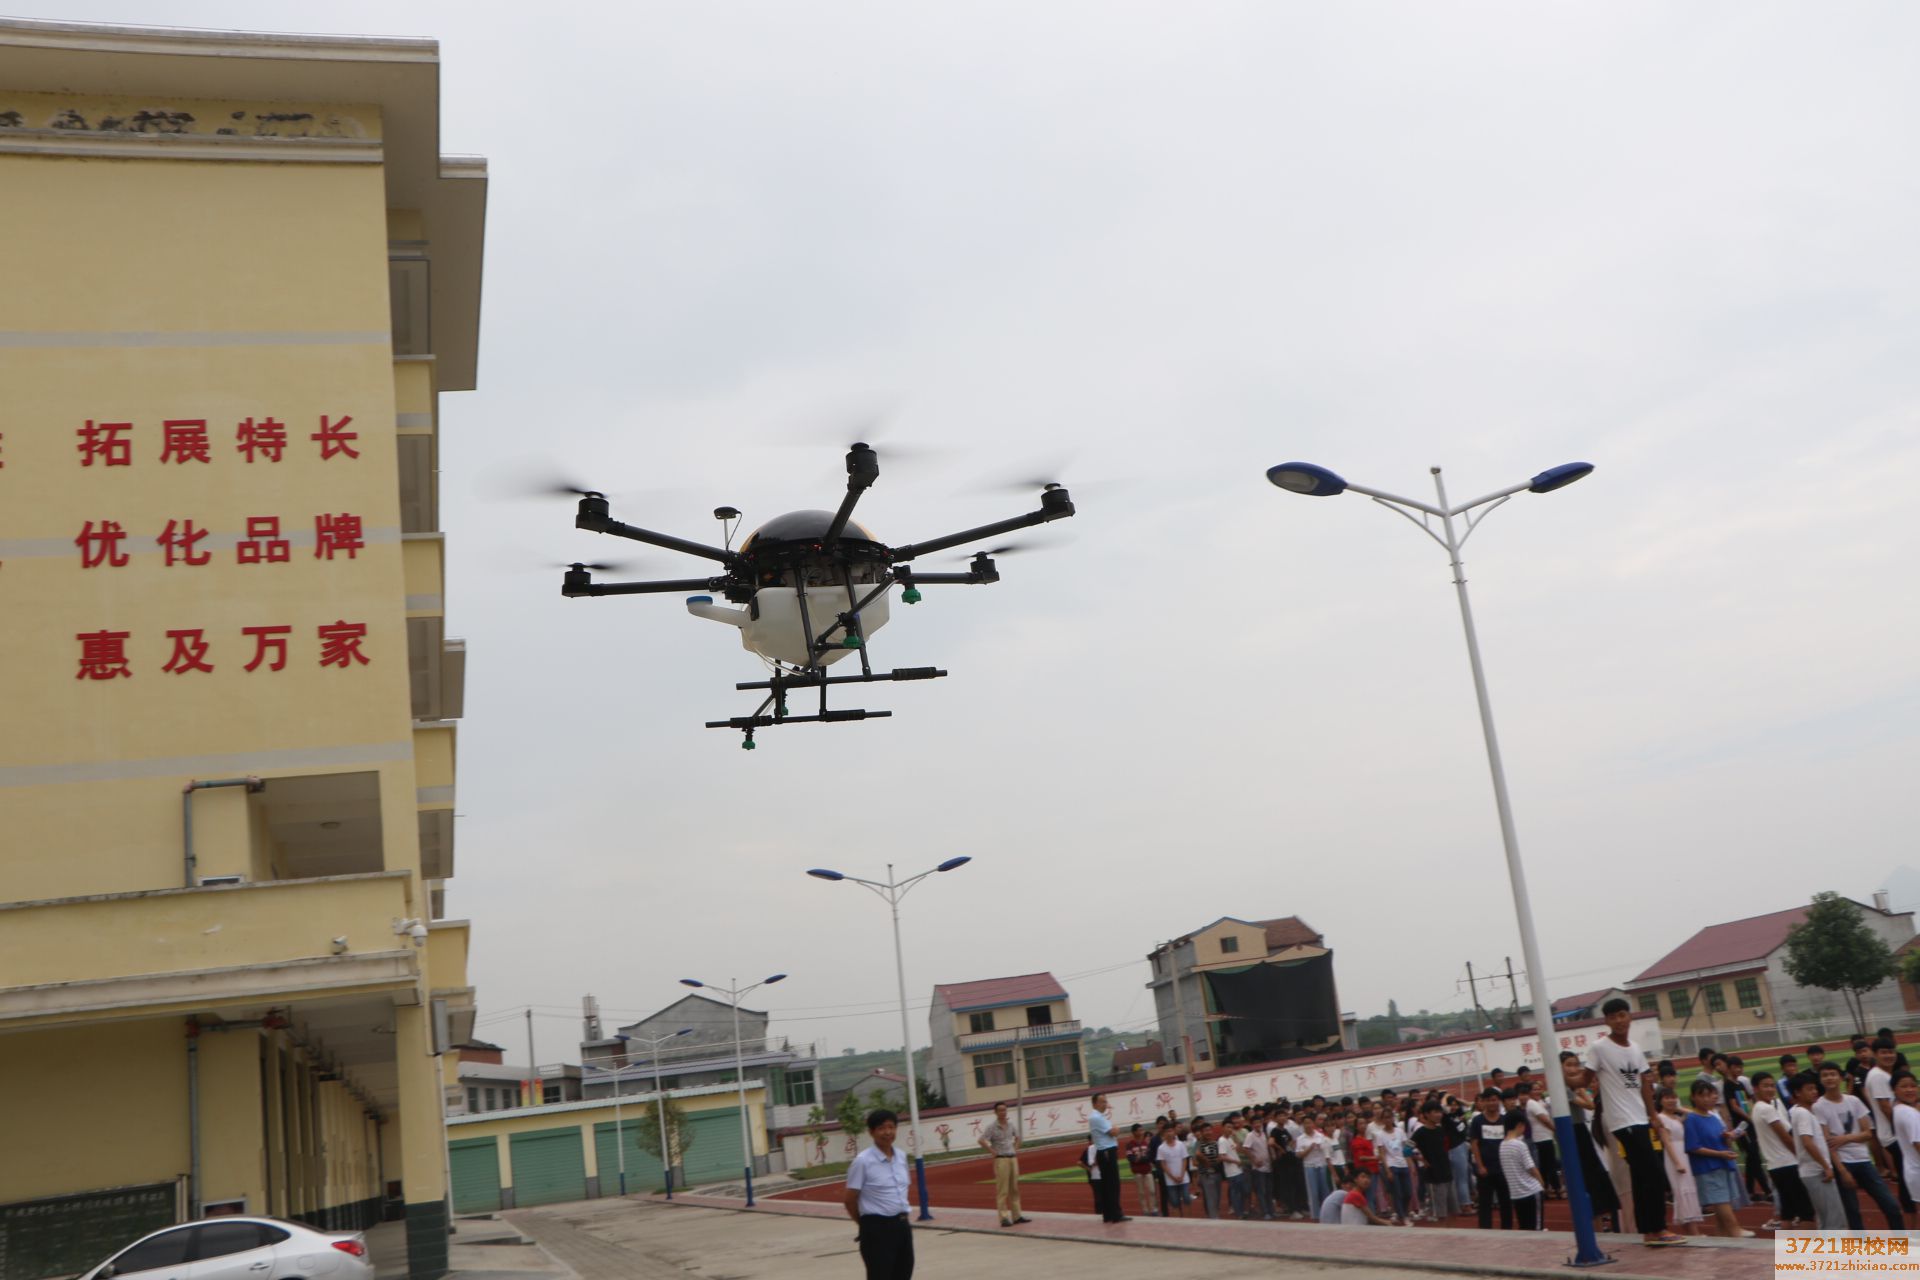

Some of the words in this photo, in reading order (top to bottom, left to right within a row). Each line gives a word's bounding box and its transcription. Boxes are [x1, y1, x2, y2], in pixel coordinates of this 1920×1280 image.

[77, 415, 359, 466] 拓展特长
[75, 513, 364, 568] 优化品牌
[77, 621, 370, 680] 惠及万家
